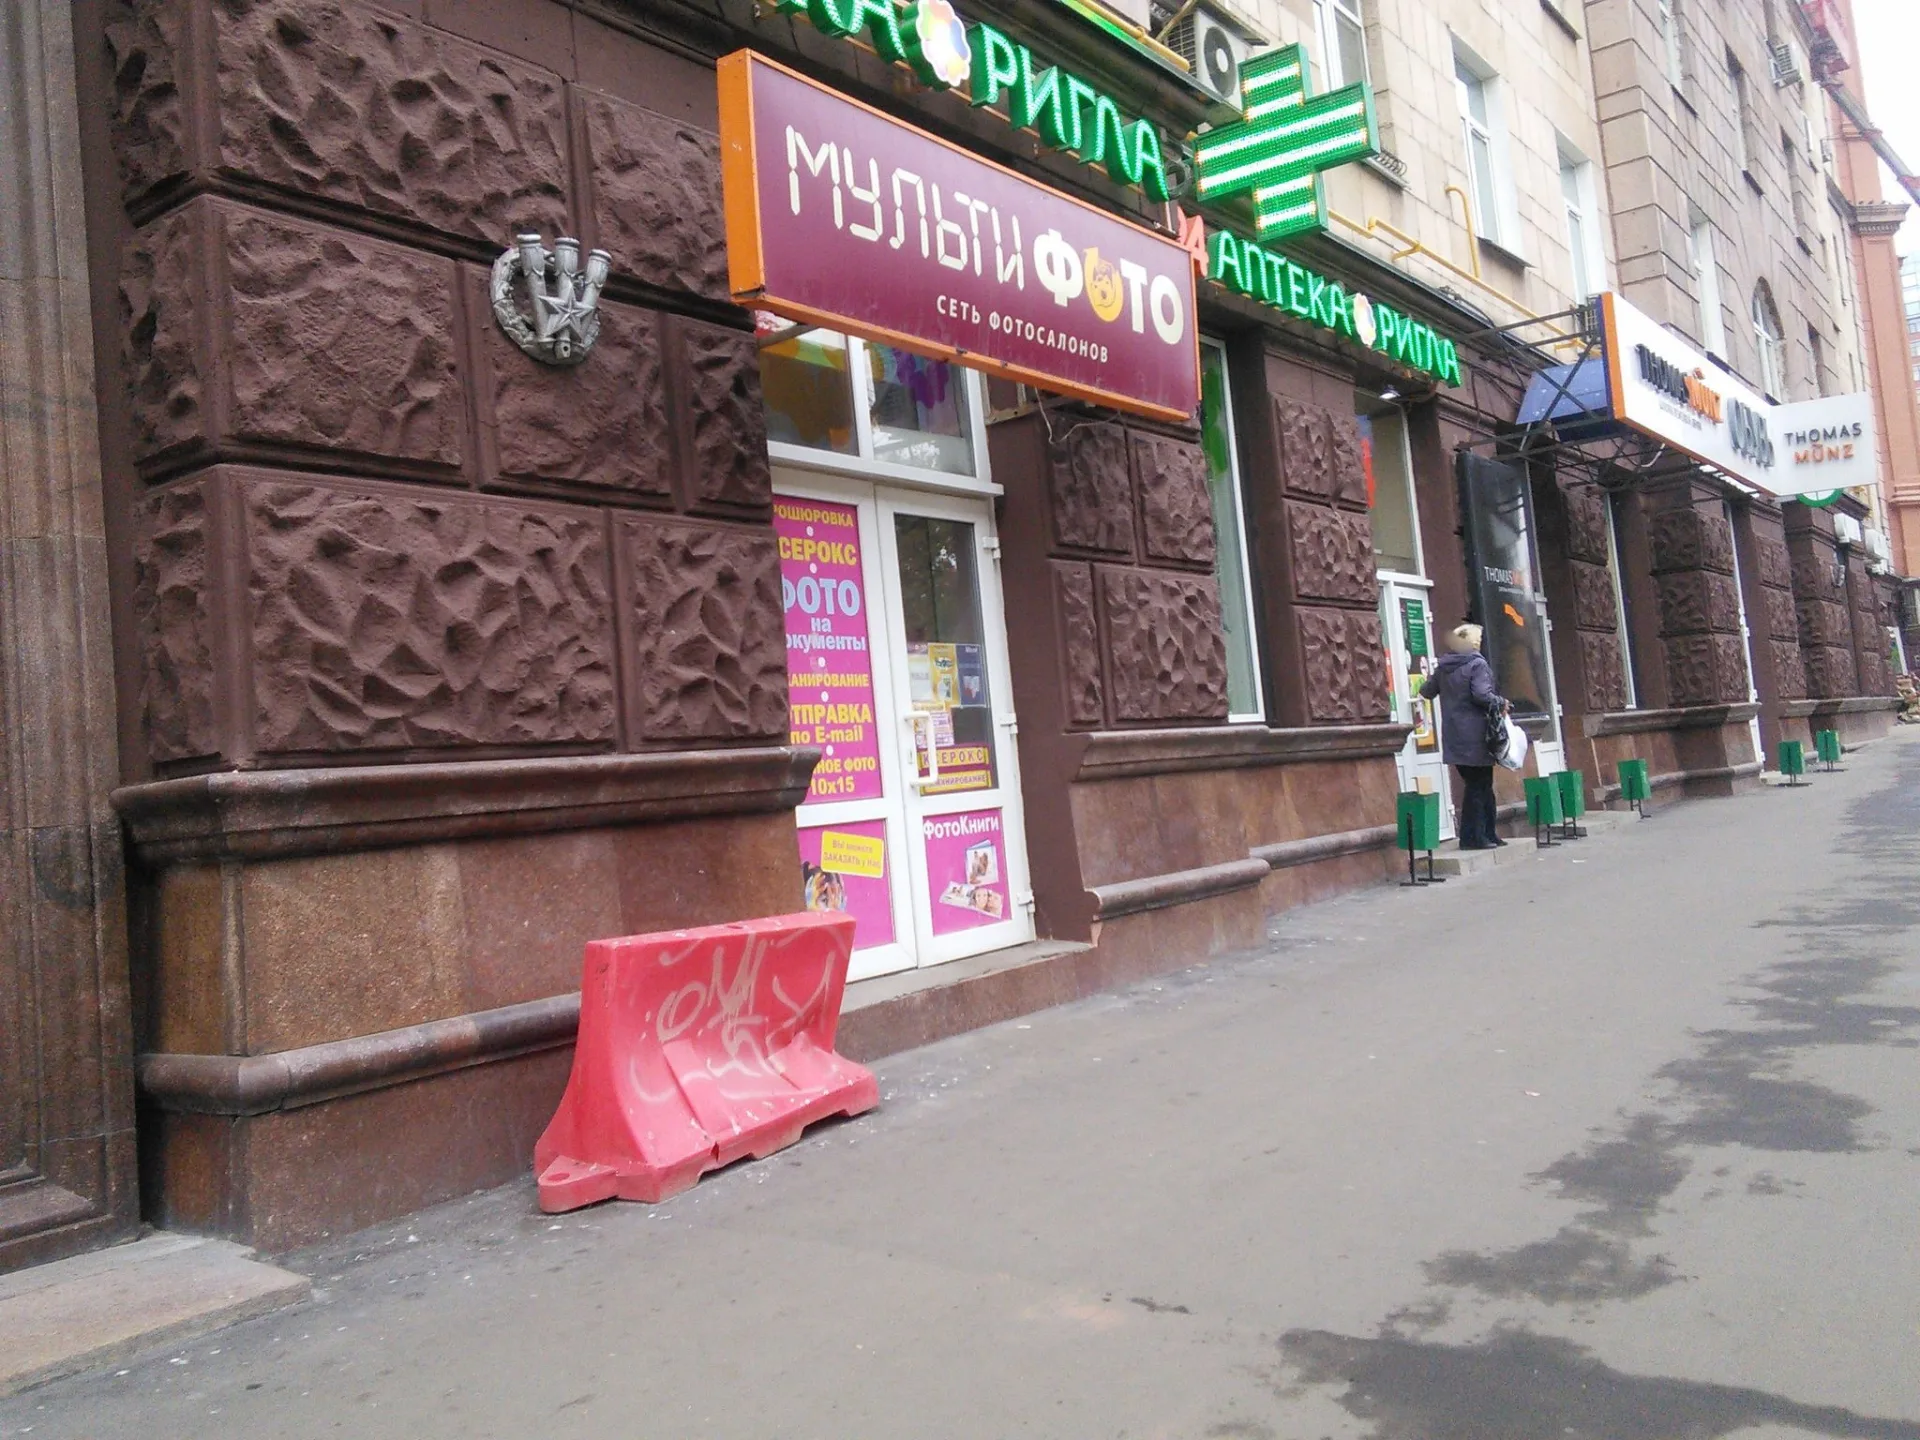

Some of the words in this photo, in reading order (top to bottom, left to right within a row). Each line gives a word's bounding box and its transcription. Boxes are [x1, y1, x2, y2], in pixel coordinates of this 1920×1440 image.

[975, 22, 1169, 200] РИГЛА
[786, 124, 1024, 291] МУЛЬТИ
[1033, 227, 1184, 346] ФОТО
[1211, 229, 1353, 336] АПТЕКА
[1376, 303, 1462, 388] РИГЛА
[936, 294, 981, 325] СЕТЬ
[987, 306, 1110, 365] ФОТОСАЛОНОВ
[1783, 422, 1862, 447] THOMAS
[778, 536, 857, 566] СЕРОКС
[810, 616, 832, 633] на
[788, 672, 870, 688] АНИРОВАНИЕ
[790, 703, 873, 725] ТПРАВКА
[790, 730, 811, 745] по
[815, 724, 864, 744] E-mail
[843, 756, 876, 773] ФОТО
[923, 815, 1000, 841] ФотоКниги
